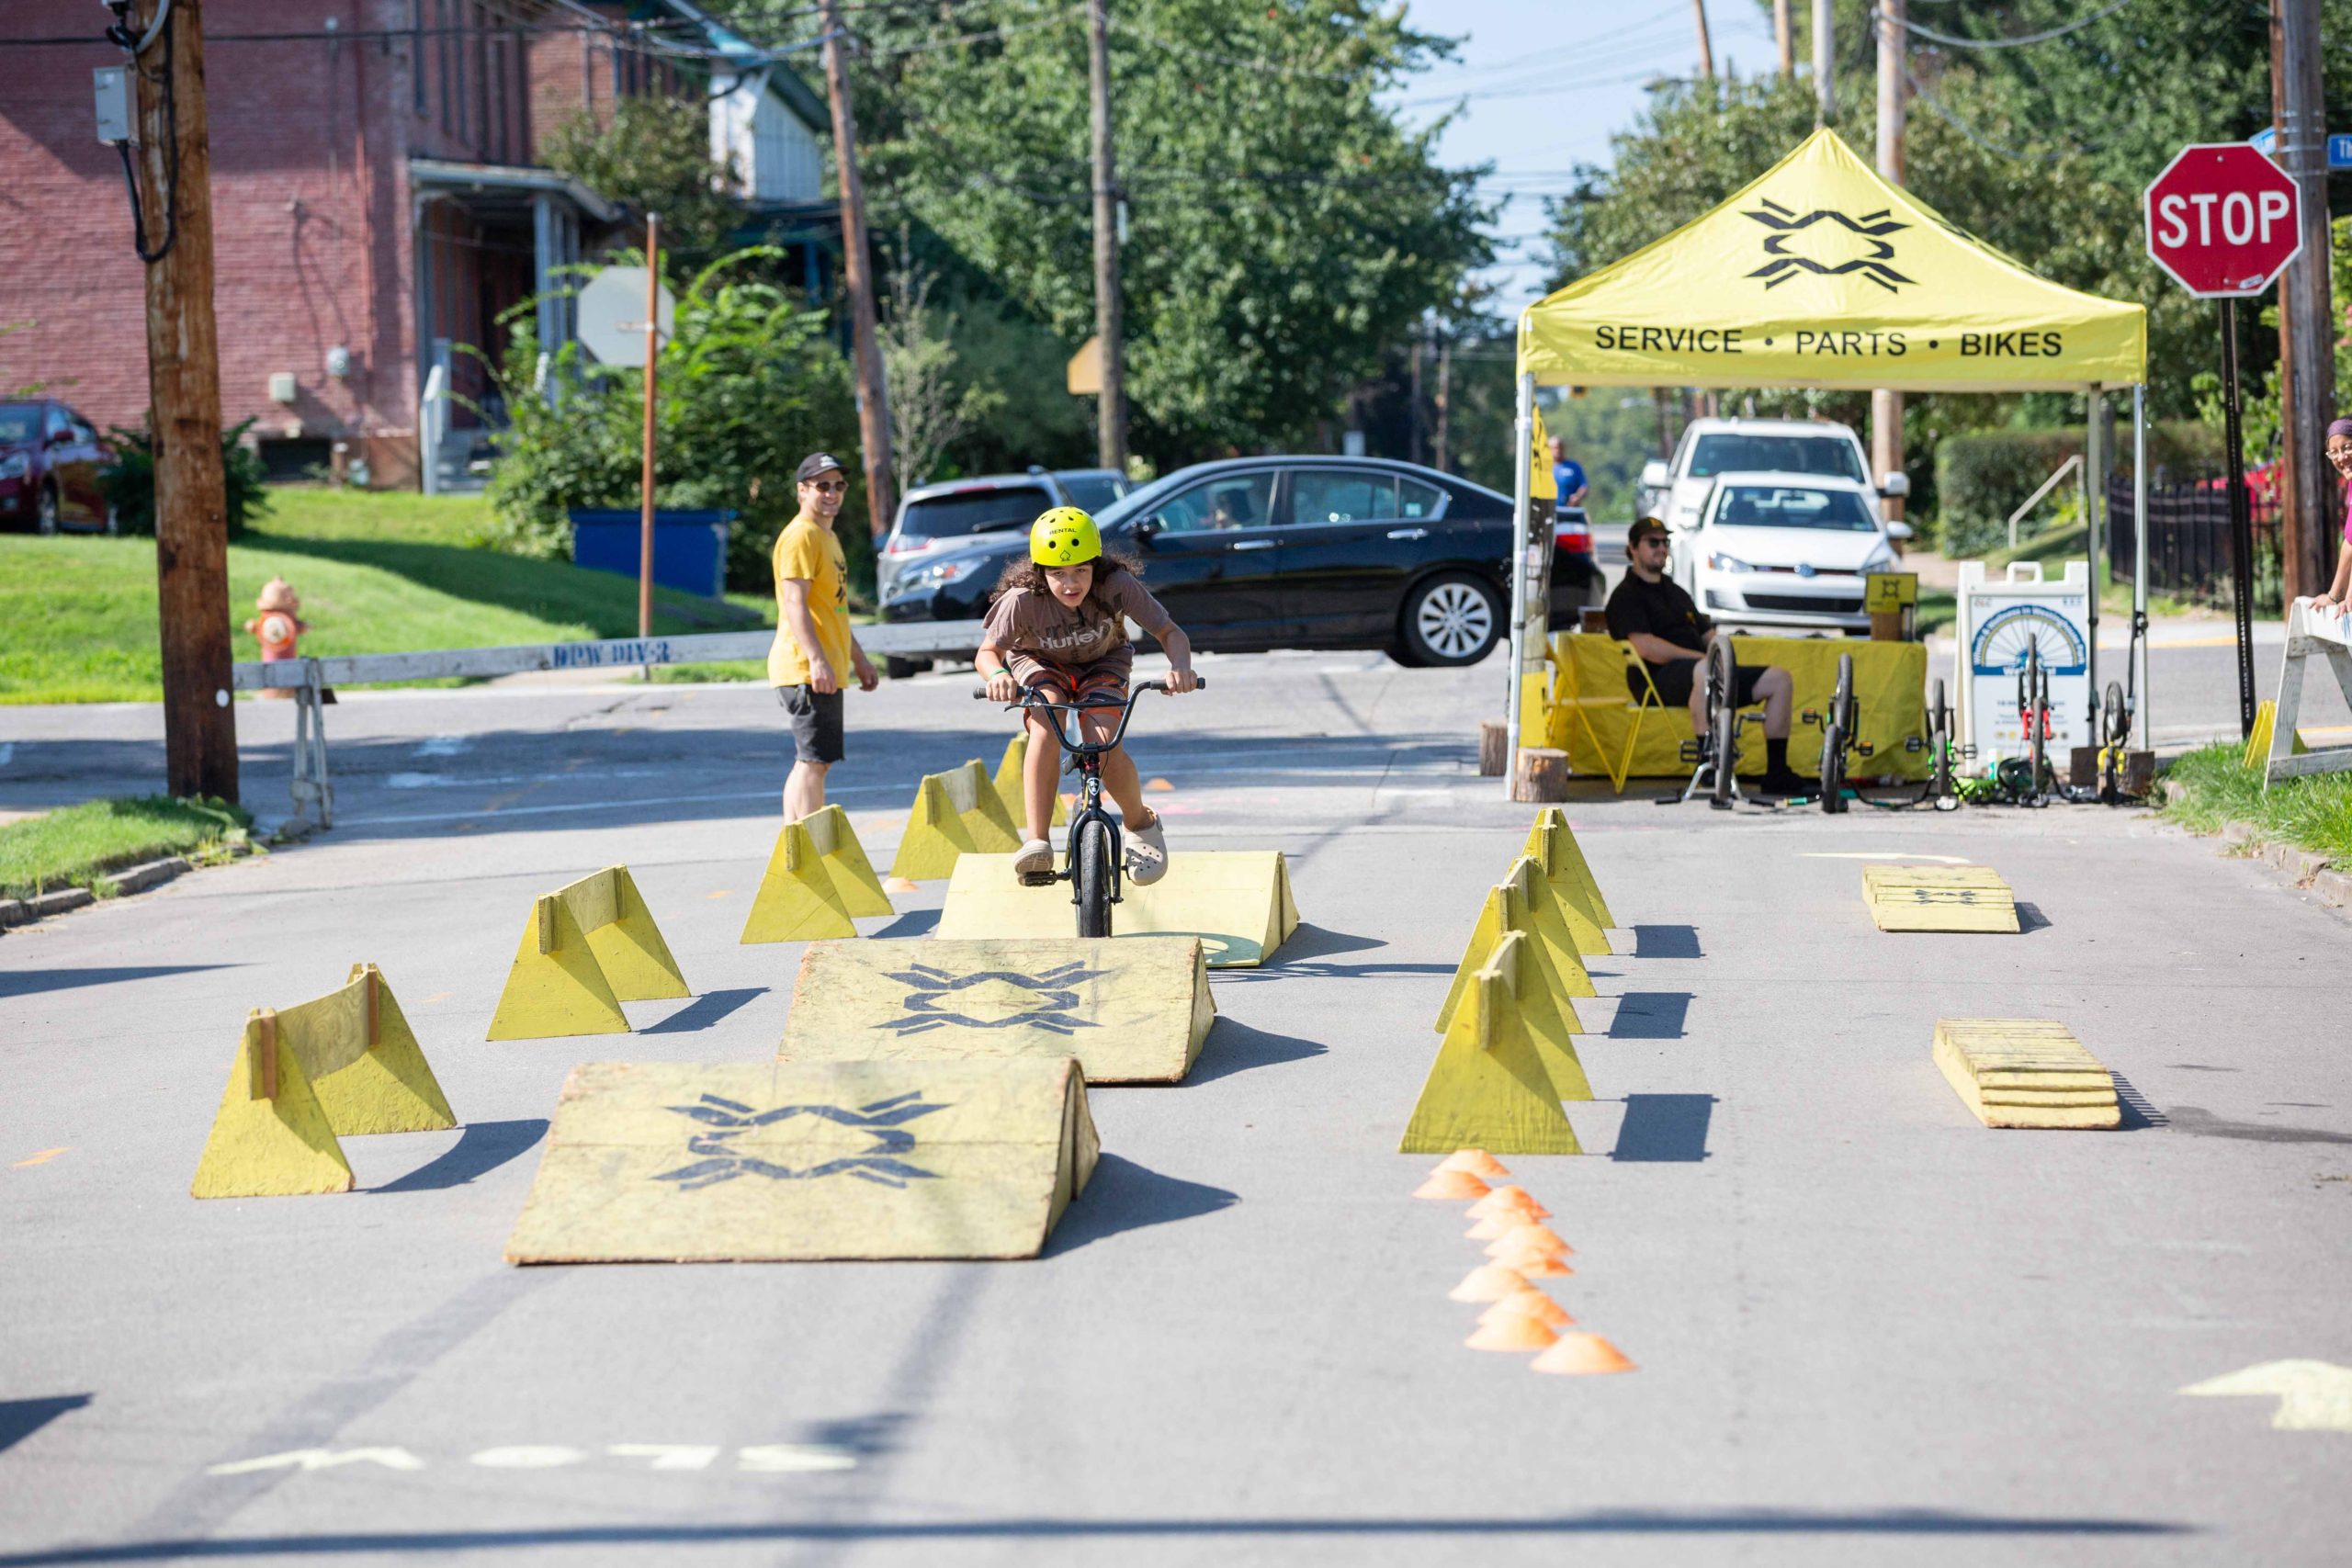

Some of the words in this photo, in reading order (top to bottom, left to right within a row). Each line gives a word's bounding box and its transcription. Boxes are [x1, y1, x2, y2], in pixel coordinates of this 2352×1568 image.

[2159, 190, 2290, 248] STOP
[1595, 325, 1743, 353] SERVICE
[1795, 331, 1907, 356] PARTS
[1960, 332, 2064, 357] BIKES
[1049, 527, 1078, 536] RENTAL
[1039, 626, 1104, 649] Hurley
[553, 645, 604, 668] DPW
[205, 1443, 857, 1475] SLOW
